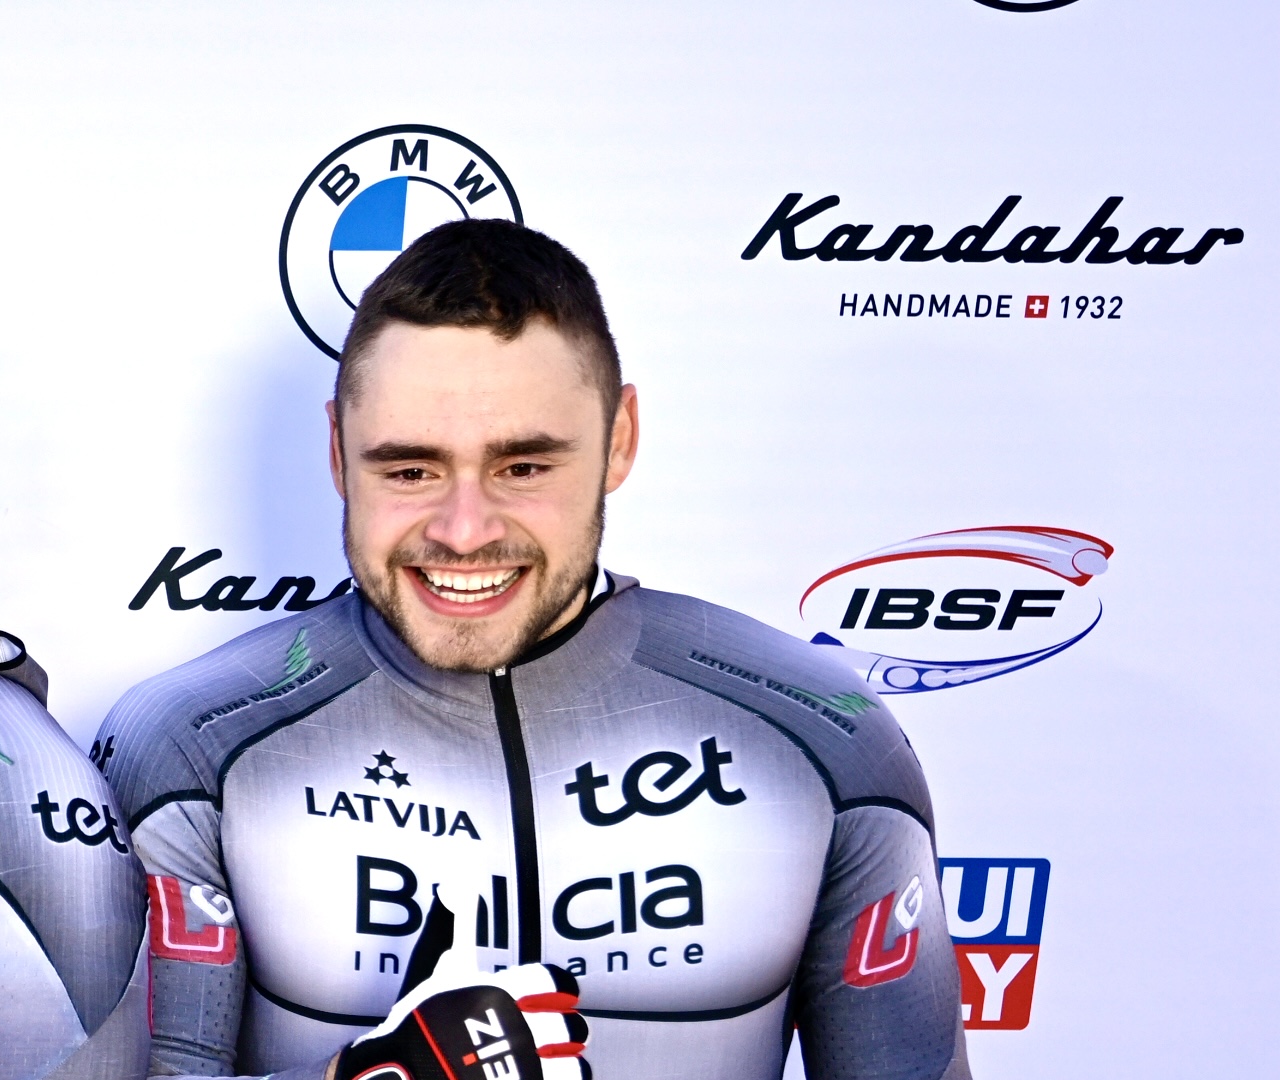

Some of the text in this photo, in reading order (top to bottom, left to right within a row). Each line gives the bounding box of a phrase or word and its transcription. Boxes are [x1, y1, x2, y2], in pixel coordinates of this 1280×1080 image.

[319, 138, 496, 205] BMW
[741, 192, 1244, 266] Kandahar
[839, 294, 1123, 319] HANDMADE 1932
[841, 588, 1065, 630] IBSF
[305, 786, 481, 840] LATVIJA
[565, 736, 747, 828] tet
[31, 790, 129, 854] tet
[356, 855, 705, 950] Blcia
[843, 874, 924, 988] LG
[354, 942, 704, 977] inance
